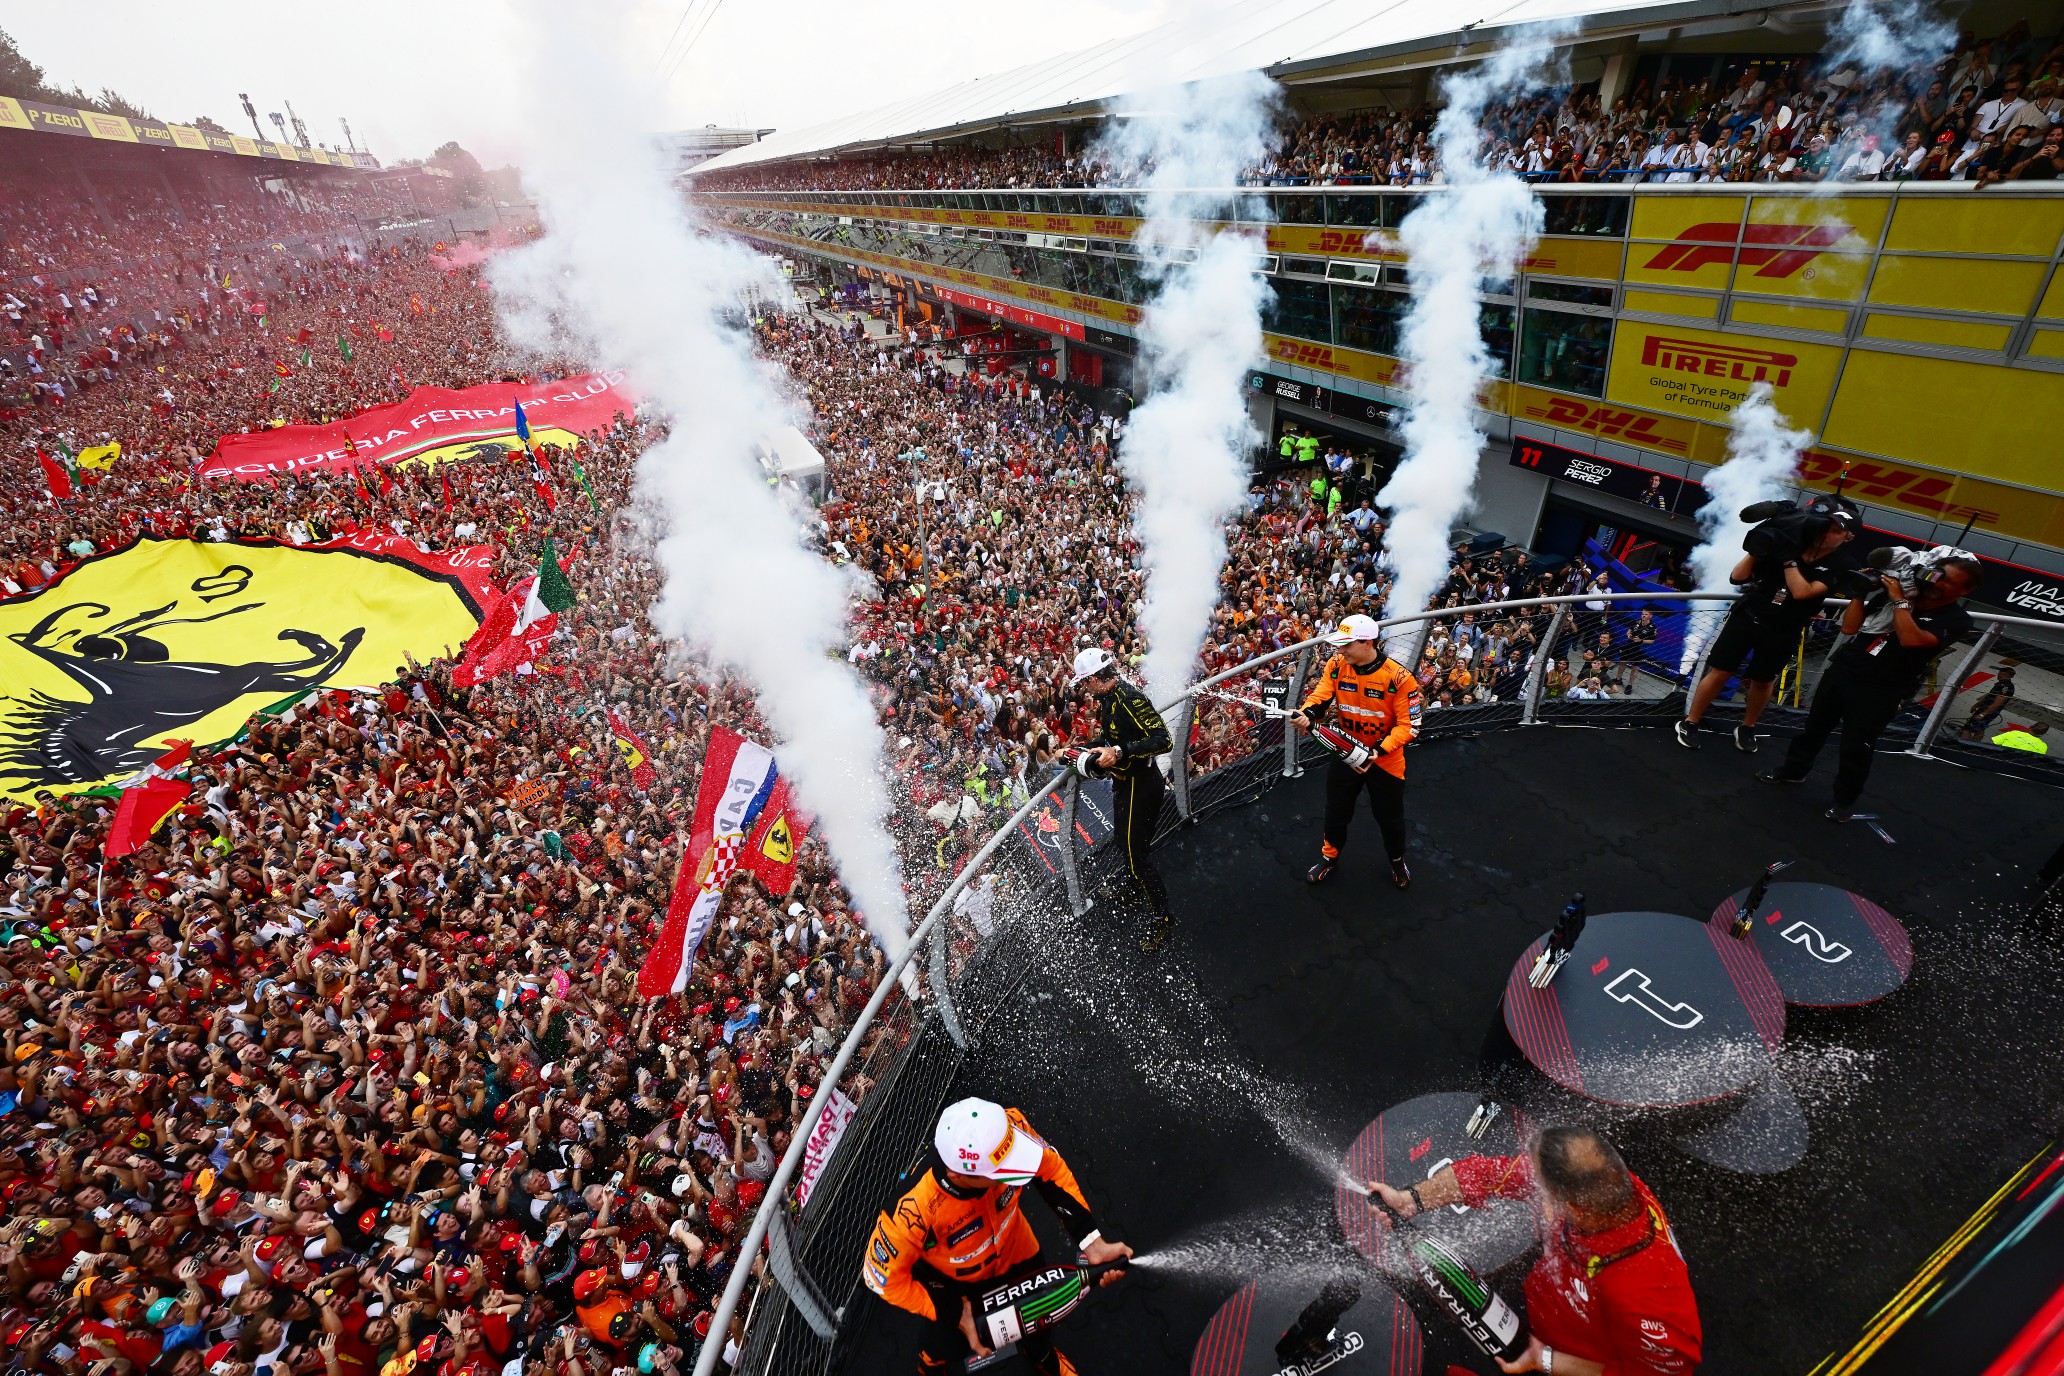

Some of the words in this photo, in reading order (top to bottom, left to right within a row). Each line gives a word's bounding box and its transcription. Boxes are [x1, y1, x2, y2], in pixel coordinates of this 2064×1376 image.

[28, 109, 39, 122] P
[41, 111, 83, 128] ZERO
[91, 117, 128, 138] PIRELLI
[134, 127, 142, 136] P
[145, 128, 171, 140] ZERO
[206, 136, 212, 145] P
[213, 137, 231, 148] ZERO
[974, 213, 994, 225] DHL
[1006, 215, 1030, 229] DHL
[1045, 217, 1076, 233] DHL
[1094, 220, 1128, 236] DHL
[959, 272, 980, 286] DHL
[991, 279, 1014, 294] DHL
[1028, 287, 1056, 303] DHL
[1071, 296, 1105, 315] DHL
[1277, 341, 1338, 368] DHL
[1641, 335, 1798, 387] PIRELLI
[552, 370, 627, 404] CLUB
[1252, 376, 1264, 389] 63
[1277, 381, 1301, 392] GEORGE
[1649, 377, 1687, 391] Global
[1689, 383, 1717, 398] Tyre
[1275, 387, 1300, 400] RUSSELL
[1664, 391, 1678, 402] of
[1679, 394, 1731, 412] Formula
[1545, 397, 1664, 445] DHL
[1520, 447, 1543, 467] 11
[1564, 468, 1603, 485] PEREZ
[1568, 458, 1612, 477] SERGIO
[1796, 451, 1960, 512] DHL
[1342, 717, 1385, 735] OKX
[516, 789, 546, 807] ANDO!
[1781, 921, 1852, 963] 2
[1604, 968, 1703, 1029] 1
[958, 1148, 980, 1161] 3RD
[947, 1208, 977, 1233] Android
[982, 1268, 1066, 1312] FERRARI
[1420, 1265, 1502, 1356] FERRARI
[1641, 1319, 1665, 1332] aws
